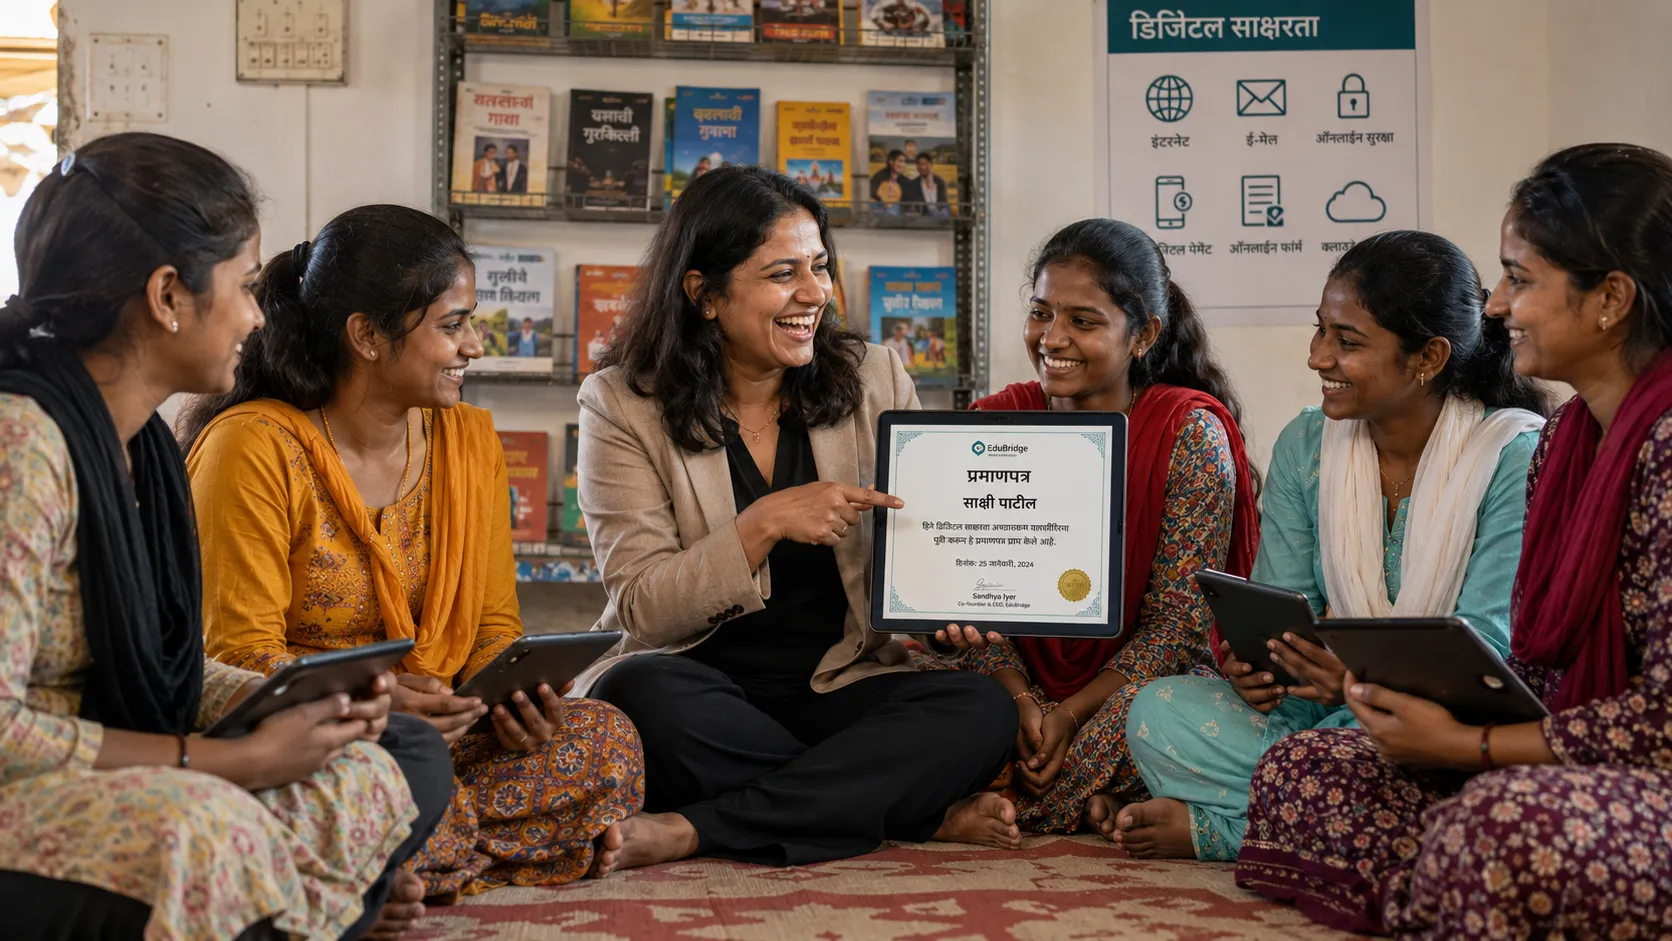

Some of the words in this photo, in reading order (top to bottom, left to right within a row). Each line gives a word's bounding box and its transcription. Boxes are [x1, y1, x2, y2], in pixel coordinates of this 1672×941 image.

[1230, 16, 1320, 40] साक्षरता
[1151, 133, 1190, 149] इंटरनेट
[1246, 131, 1278, 147] ई-मेल
[1316, 130, 1363, 144] ऑनलाईन
[1366, 132, 1395, 146] सुरक्षा
[987, 444, 1029, 454] EduBridge
[967, 470, 1031, 483] प्रमाणपत्र
[963, 493, 996, 510] साक्षी
[998, 493, 1037, 510] पाटील
[1017, 560, 1034, 568] 2024
